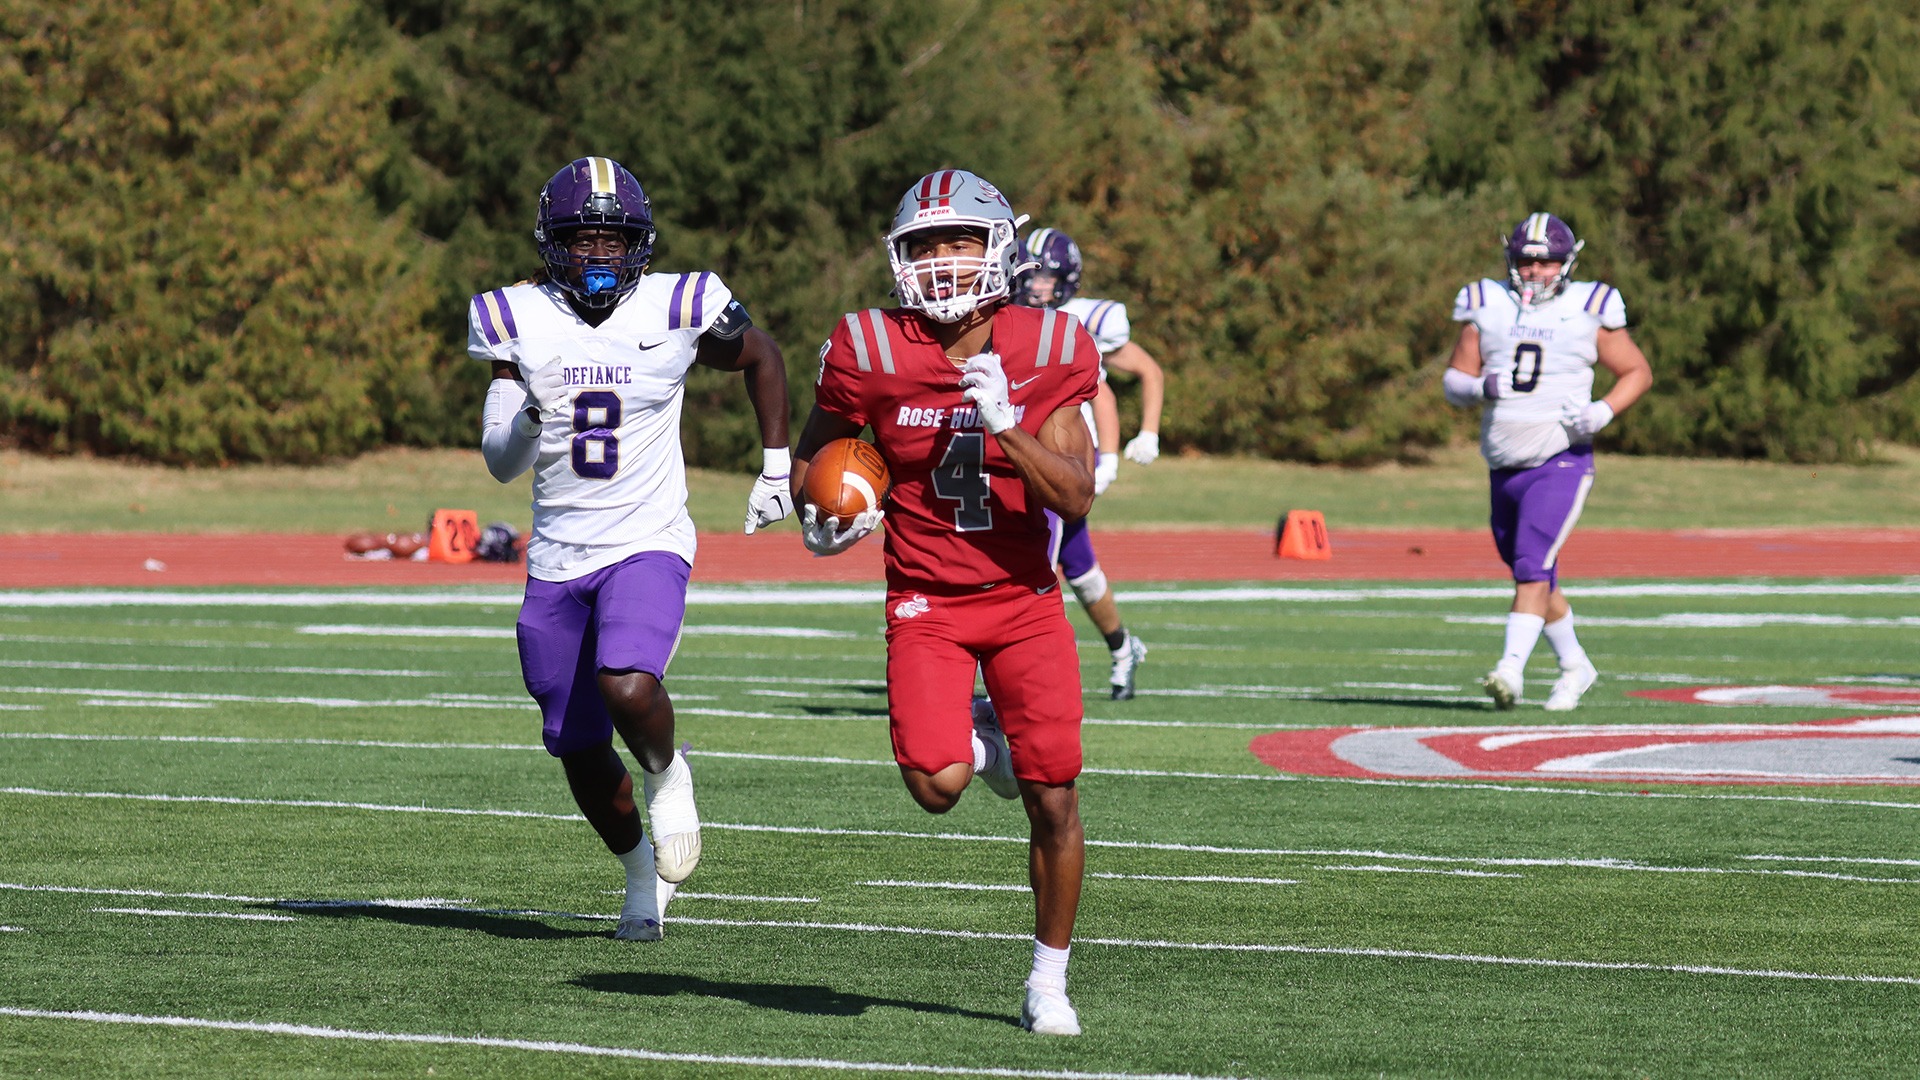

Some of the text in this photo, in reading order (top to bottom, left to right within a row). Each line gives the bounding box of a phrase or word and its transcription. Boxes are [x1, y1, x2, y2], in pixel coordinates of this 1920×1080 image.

[918, 208, 951, 219] WE WORK
[562, 365, 632, 386] DEFIANCE
[1511, 341, 1543, 394] 0
[569, 386, 624, 482] 8
[931, 432, 993, 532] 4
